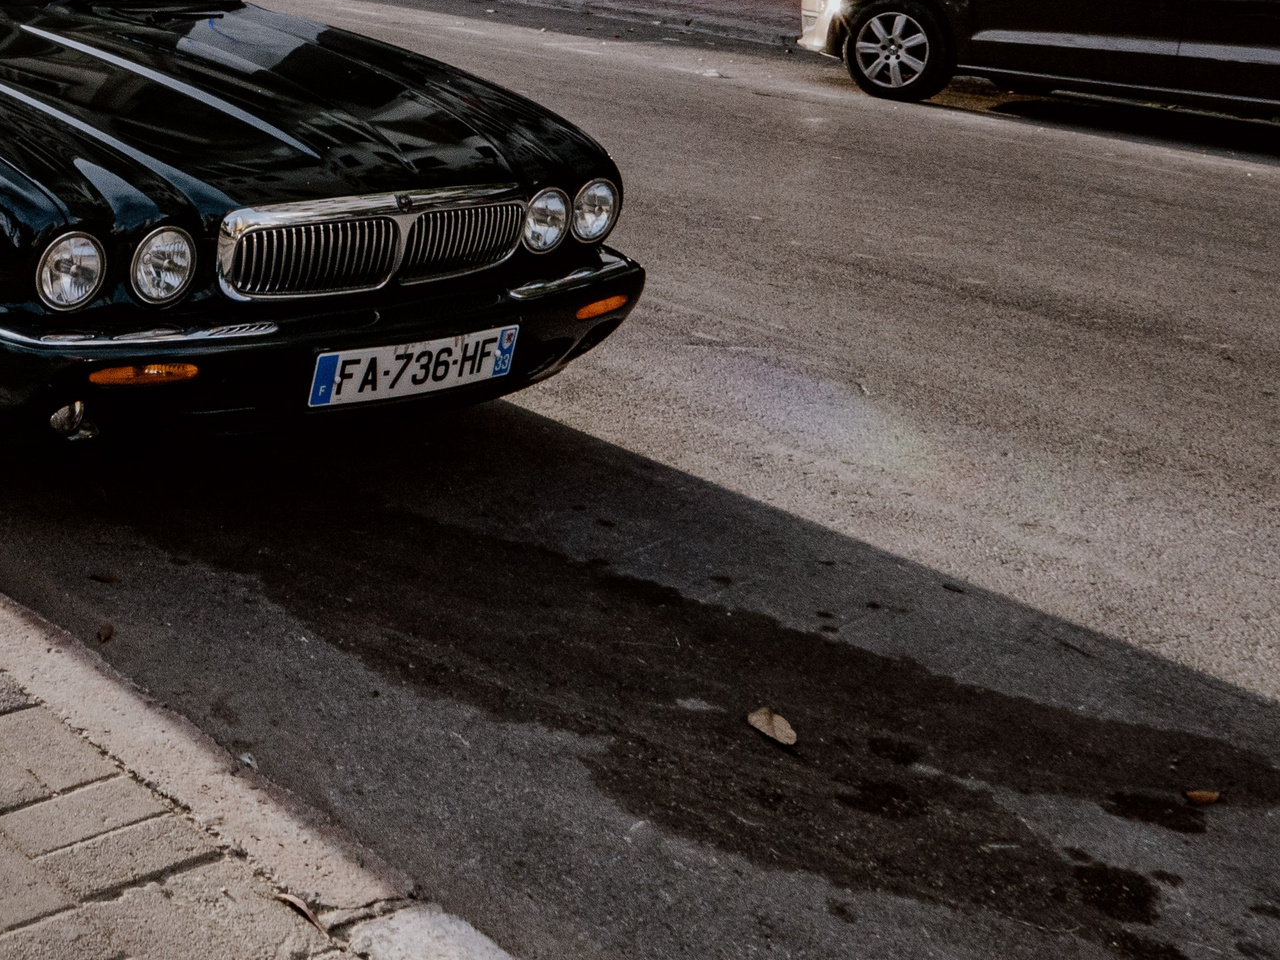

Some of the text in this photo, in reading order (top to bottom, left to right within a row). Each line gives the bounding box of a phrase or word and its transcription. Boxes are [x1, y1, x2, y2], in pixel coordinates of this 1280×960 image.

[334, 336, 499, 396] FA-736-HF
[493, 353, 511, 371] 33
[318, 385, 327, 397] F
